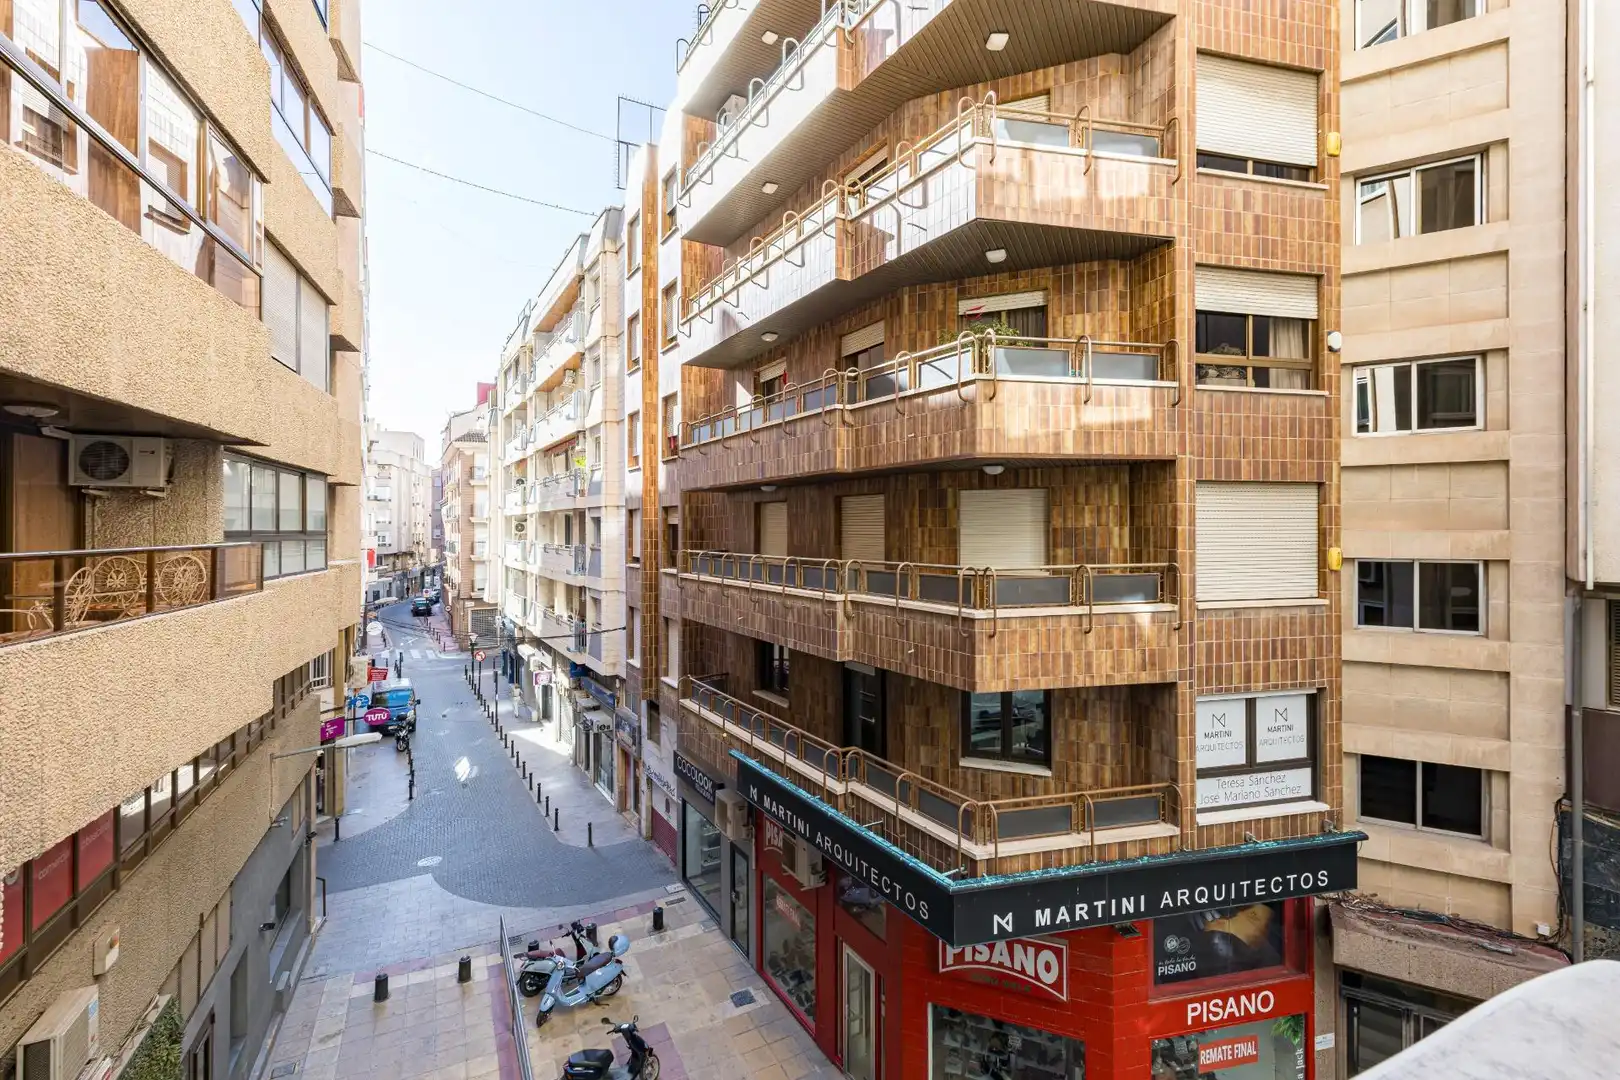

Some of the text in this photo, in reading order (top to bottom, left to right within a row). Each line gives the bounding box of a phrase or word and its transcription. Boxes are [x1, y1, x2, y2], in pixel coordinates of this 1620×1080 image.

[1204, 730, 1232, 739] MARTINI
[1267, 724, 1294, 733] MARTINI
[1196, 741, 1244, 752] ARQUITECTOS
[1259, 734, 1305, 746] ARQUITECTOS
[1216, 778, 1245, 789] Teresa
[1224, 790, 1260, 802] Mariano
[763, 794, 810, 838] MARTINI
[815, 831, 929, 920] ARQUITECTOS
[1035, 894, 1146, 928] MARTINI
[1160, 870, 1329, 909] ARQUITECTOS
[946, 939, 1059, 985] PISANO
[1157, 961, 1197, 976] PISANO
[1187, 990, 1275, 1026] PISANO
[1200, 1044, 1233, 1065] REMATE
[1234, 1041, 1257, 1059] FINAL
